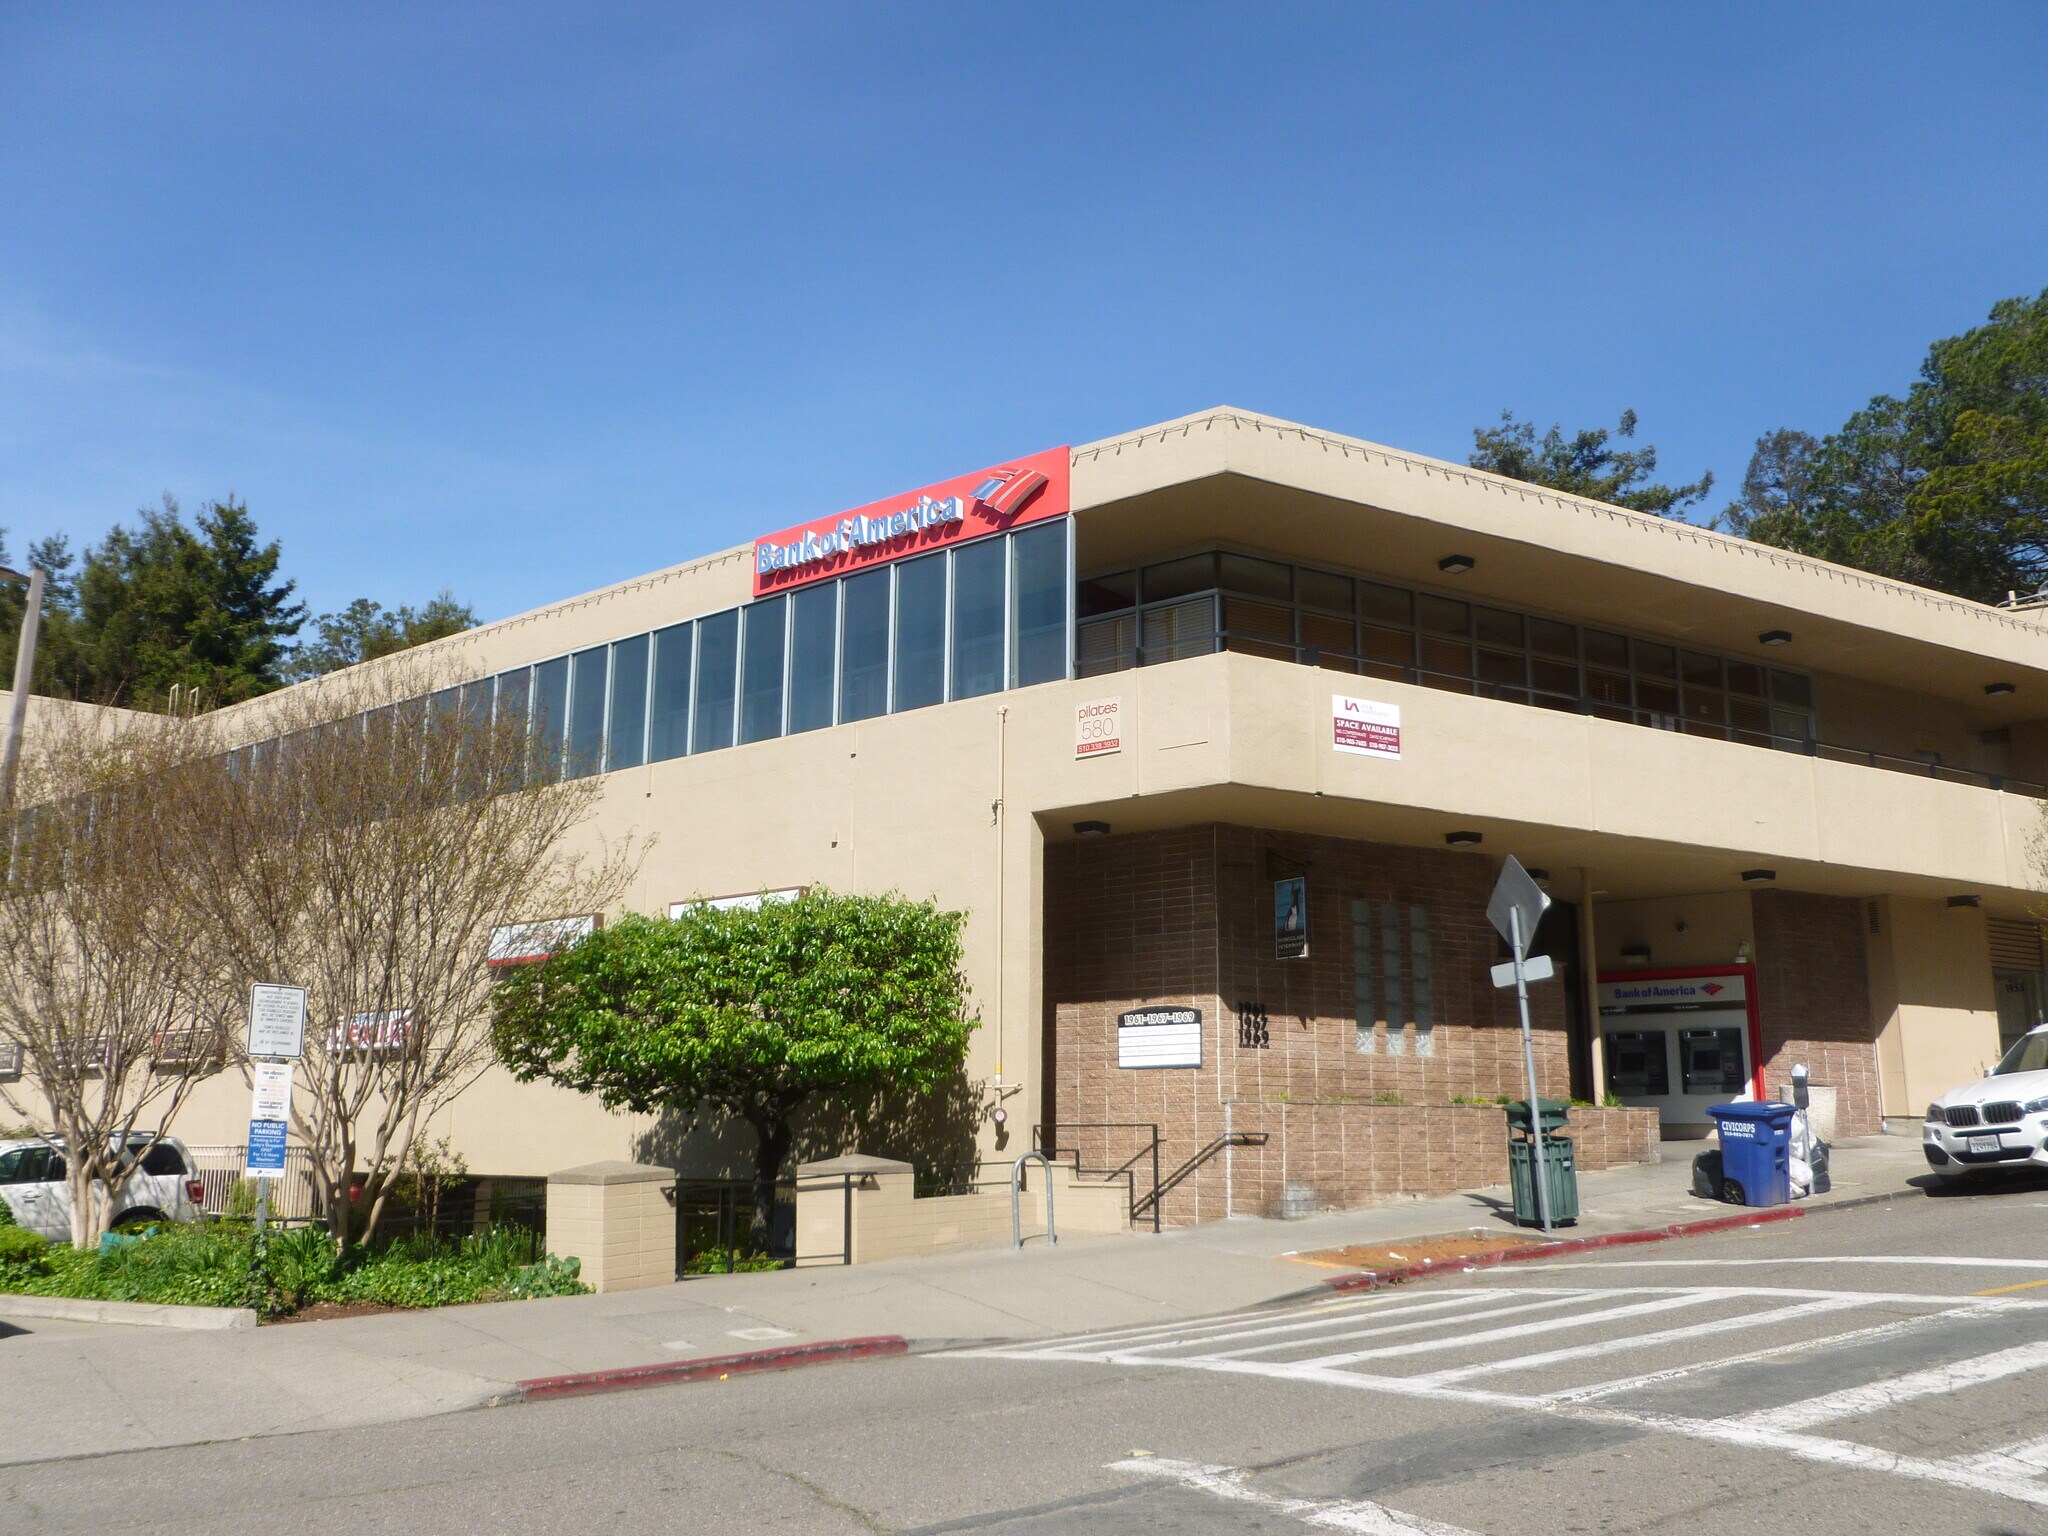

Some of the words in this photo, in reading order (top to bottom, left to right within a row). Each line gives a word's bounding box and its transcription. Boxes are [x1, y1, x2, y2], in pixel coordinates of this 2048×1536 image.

[757, 531, 823, 574] Bank
[820, 519, 850, 555] of
[848, 495, 964, 549] America
[1079, 703, 1118, 722] pilates
[1082, 718, 1114, 739] 580
[1336, 719, 1360, 730] SPACE
[1361, 723, 1398, 736] AVAILABLE
[1614, 987, 1641, 999] Bank
[1640, 986, 1652, 998] of
[1652, 985, 1696, 997] America
[1721, 1121, 1756, 1133] CIVICORPS
